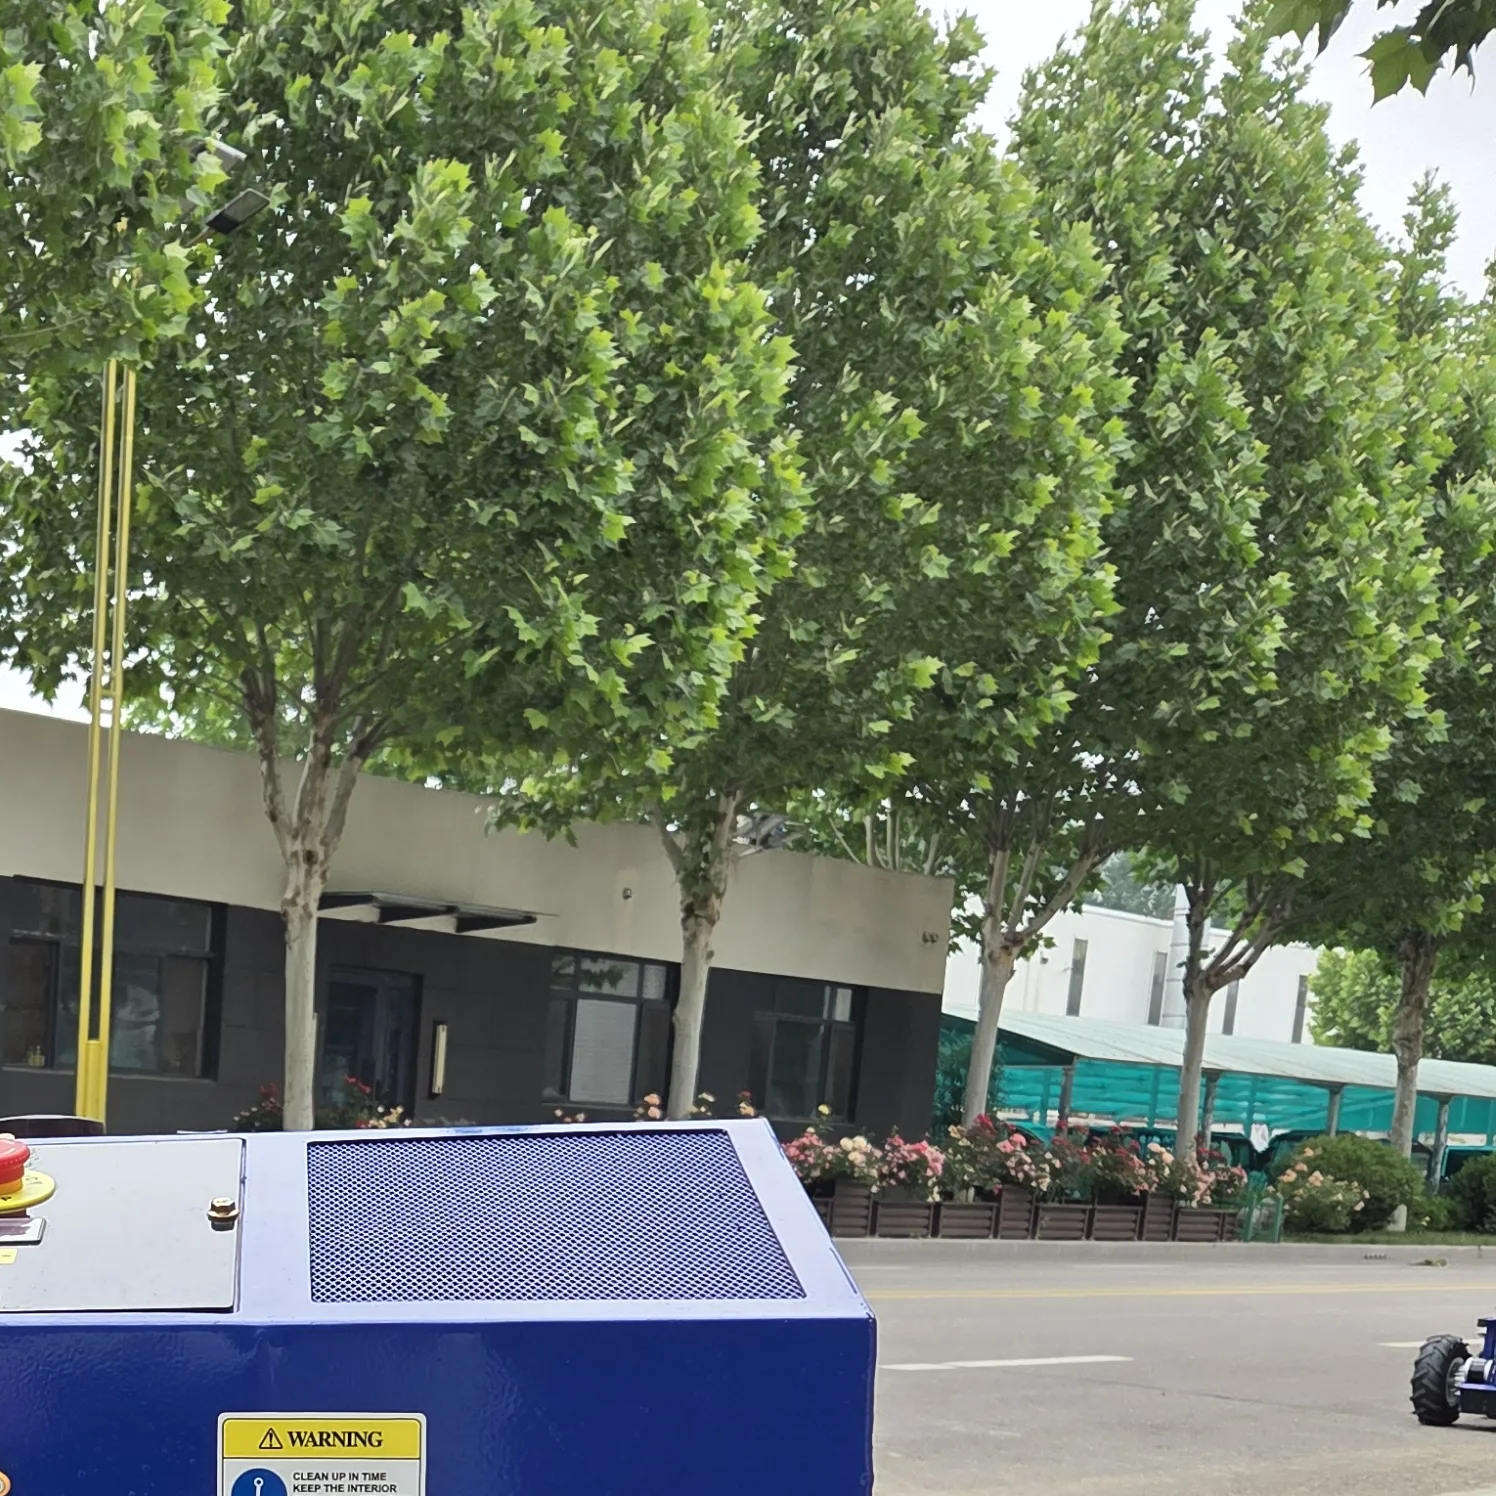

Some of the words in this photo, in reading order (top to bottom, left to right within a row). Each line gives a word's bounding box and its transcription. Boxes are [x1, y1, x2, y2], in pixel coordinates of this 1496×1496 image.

[287, 1431, 383, 1447] WARNING
[293, 1472, 328, 1481] CLEAN
[332, 1472, 346, 1481] UP
[349, 1472, 358, 1481] IN
[362, 1472, 387, 1481] TIME
[293, 1484, 321, 1493] KEEP
[324, 1484, 344, 1493] THE
[348, 1484, 397, 1493] INTERIOR
